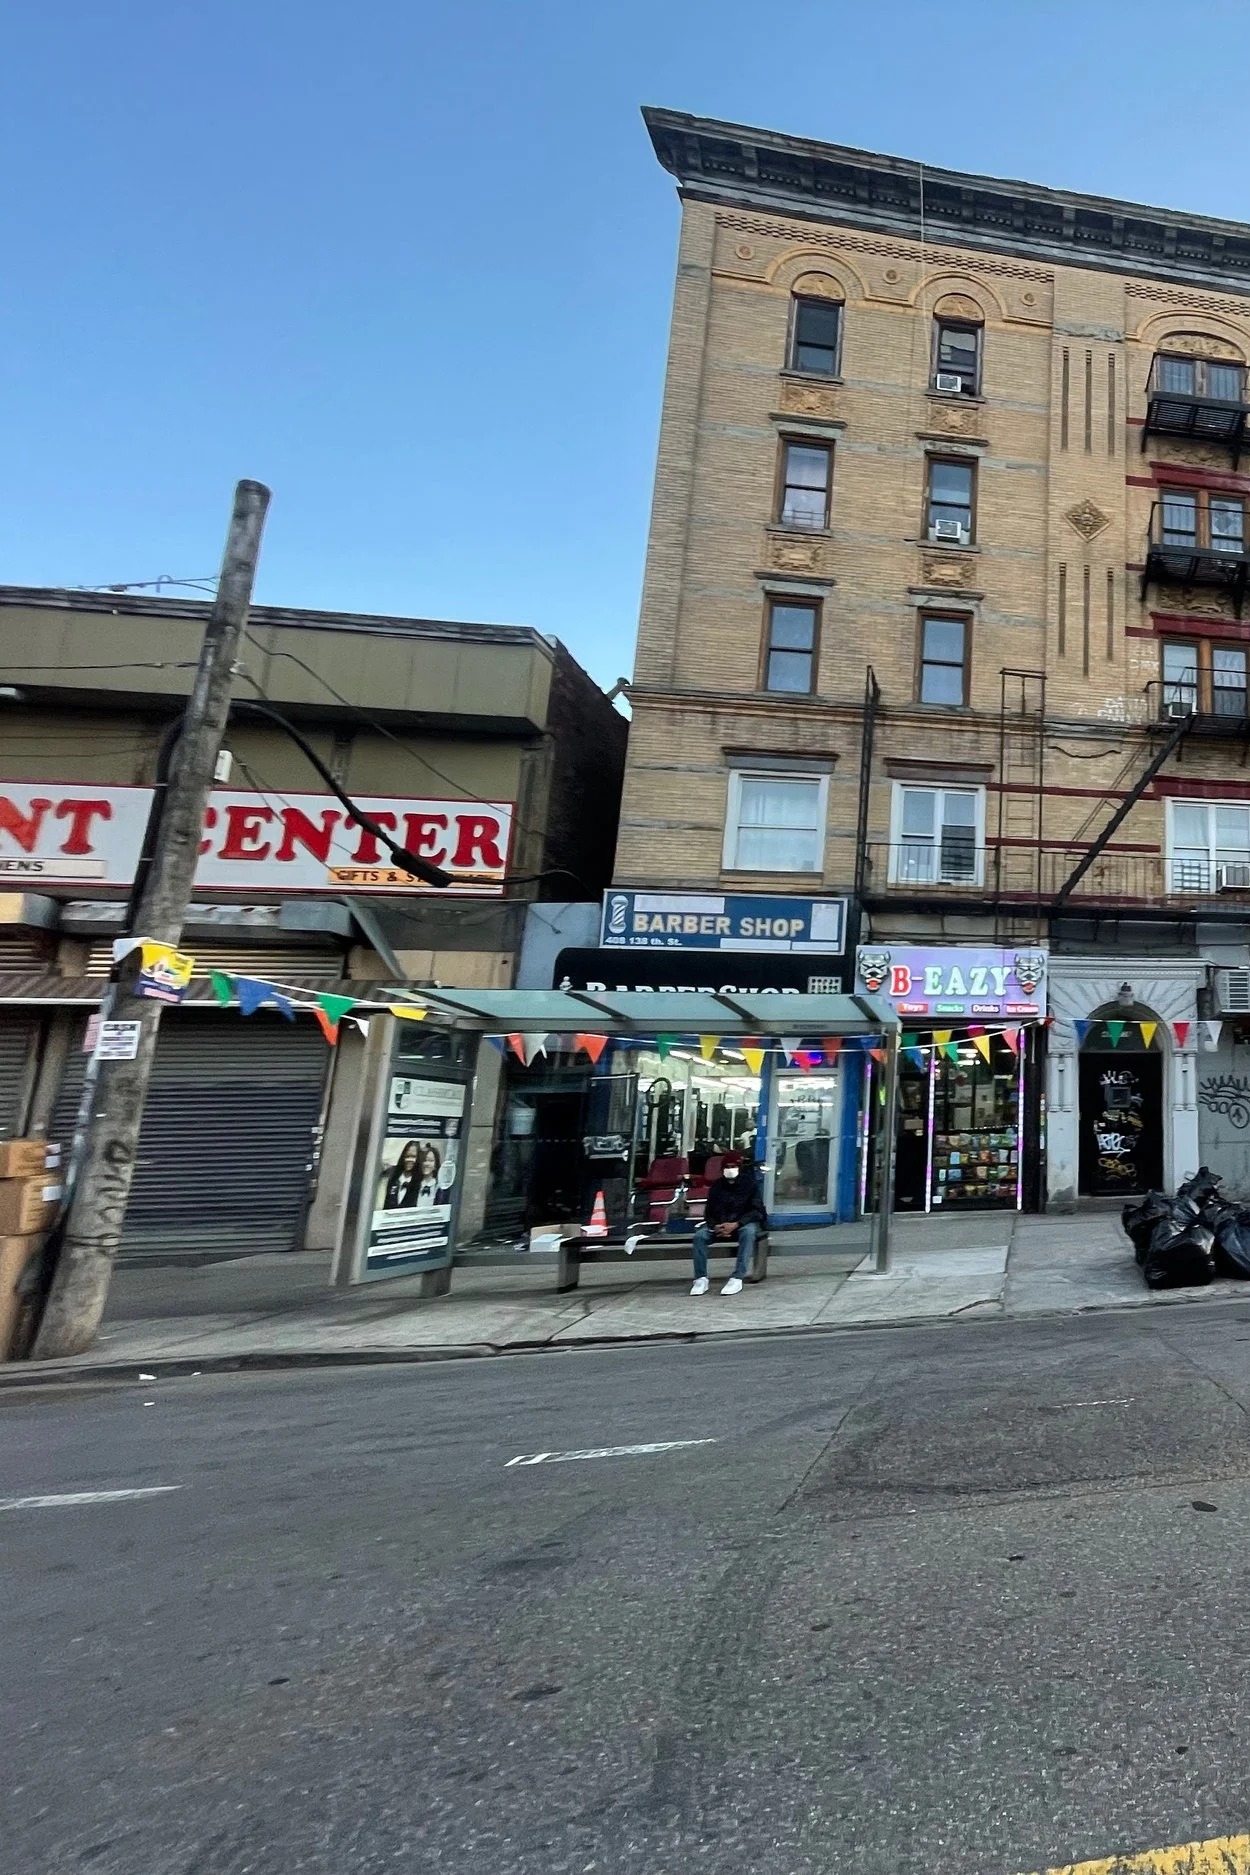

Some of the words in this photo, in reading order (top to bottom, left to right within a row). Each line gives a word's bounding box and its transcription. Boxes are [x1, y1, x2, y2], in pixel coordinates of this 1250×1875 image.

[0, 859, 45, 872] ENS
[336, 869, 379, 881] GIFTS
[387, 871, 398, 882] &
[632, 913, 732, 935] BARBER
[740, 917, 805, 937] SHOP
[889, 965, 1012, 997] B-EAZY
[903, 1003, 924, 1012] Toys
[972, 1004, 1000, 1013] Drinks
